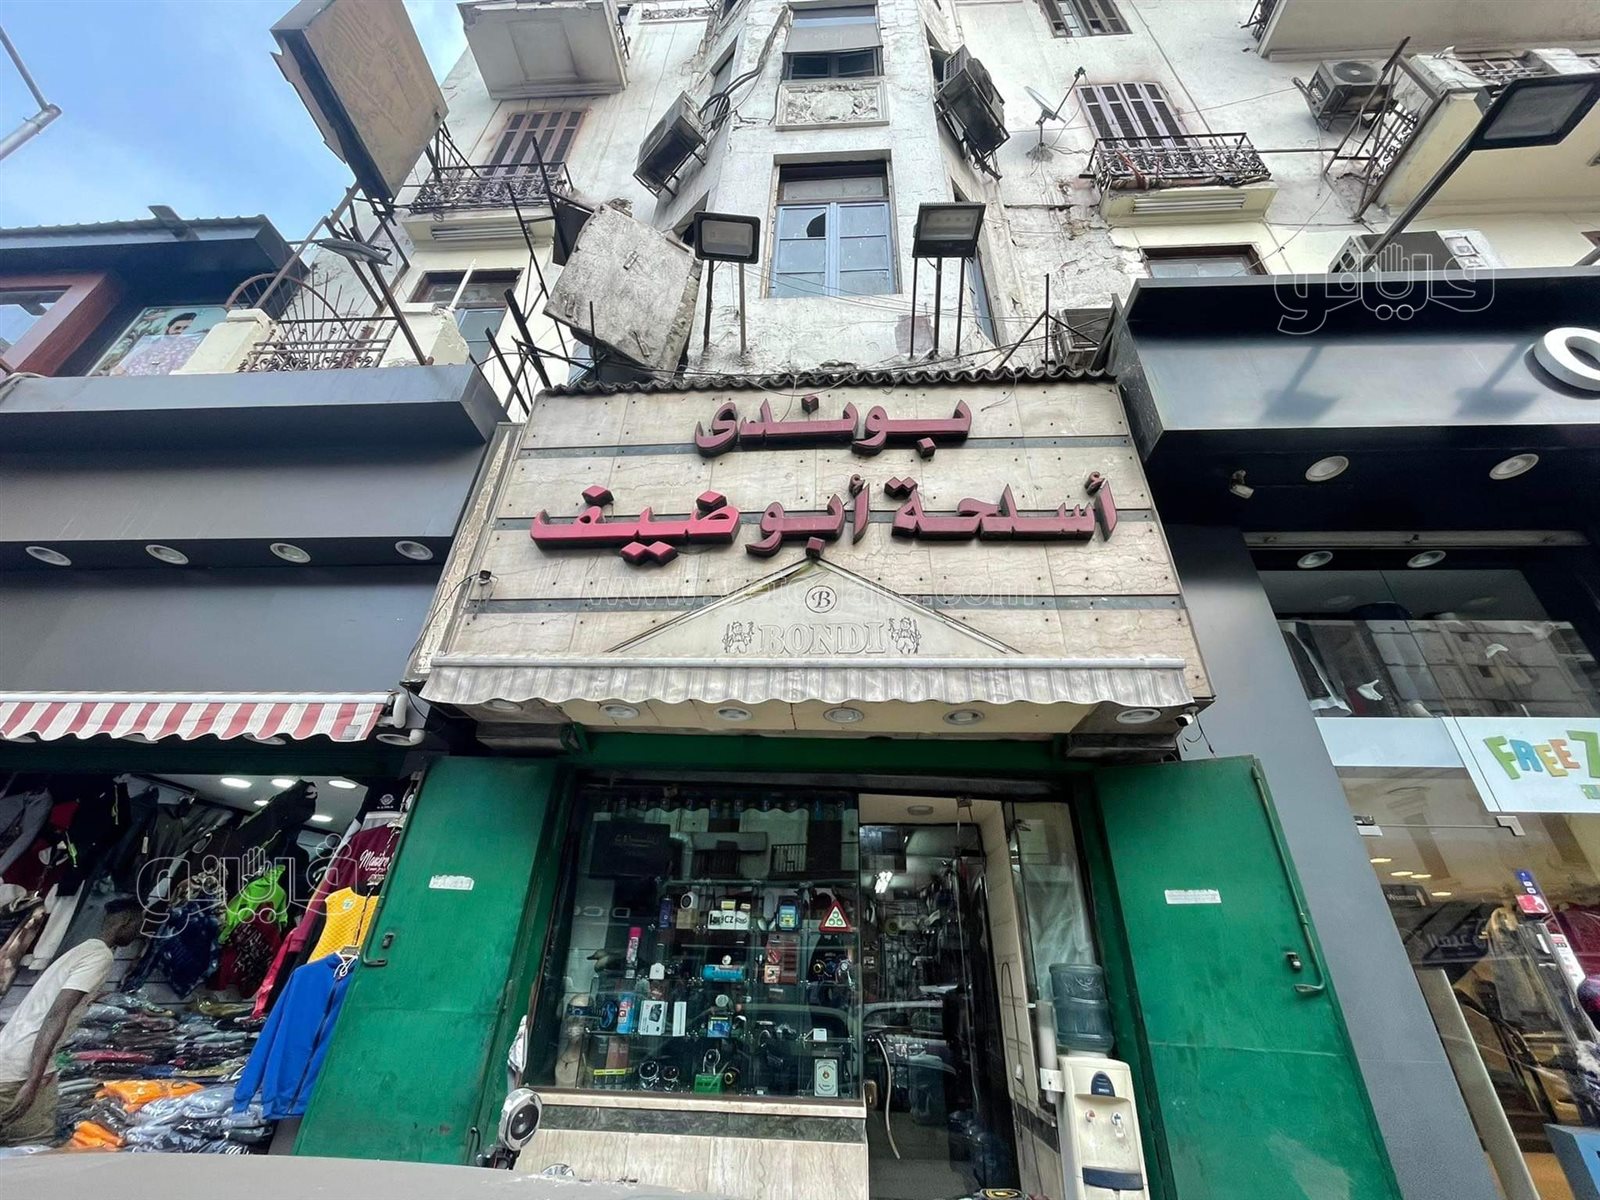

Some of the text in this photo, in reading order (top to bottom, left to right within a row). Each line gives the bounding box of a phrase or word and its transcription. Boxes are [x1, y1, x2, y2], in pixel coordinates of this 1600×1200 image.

[529, 471, 1118, 566] أسلحة أبو ضيف
[811, 590, 831, 608] B
[758, 622, 886, 655] BONDI
